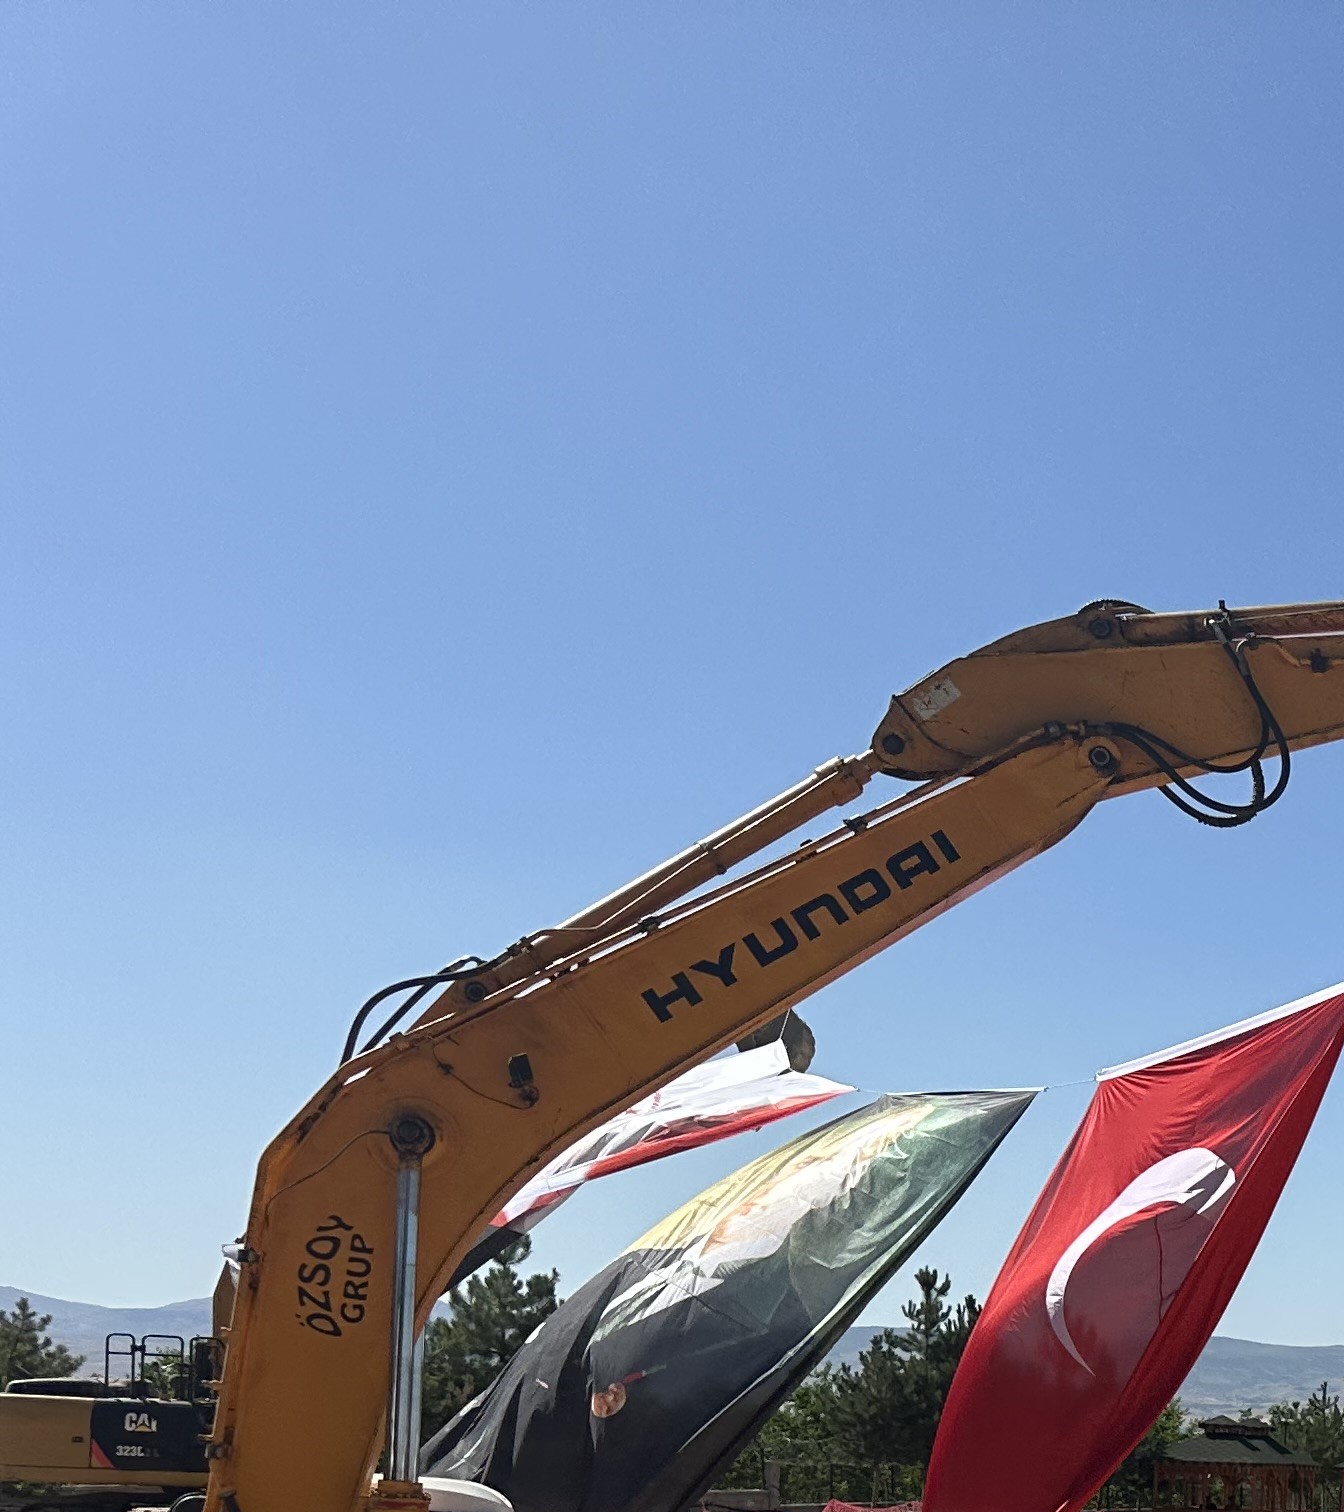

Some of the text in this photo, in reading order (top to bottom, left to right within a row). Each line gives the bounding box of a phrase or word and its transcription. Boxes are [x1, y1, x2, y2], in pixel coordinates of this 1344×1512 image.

[640, 829, 961, 1024] HYUNDAI
[294, 1214, 354, 1338] ÖZSOY
[340, 1233, 375, 1325] GRUP
